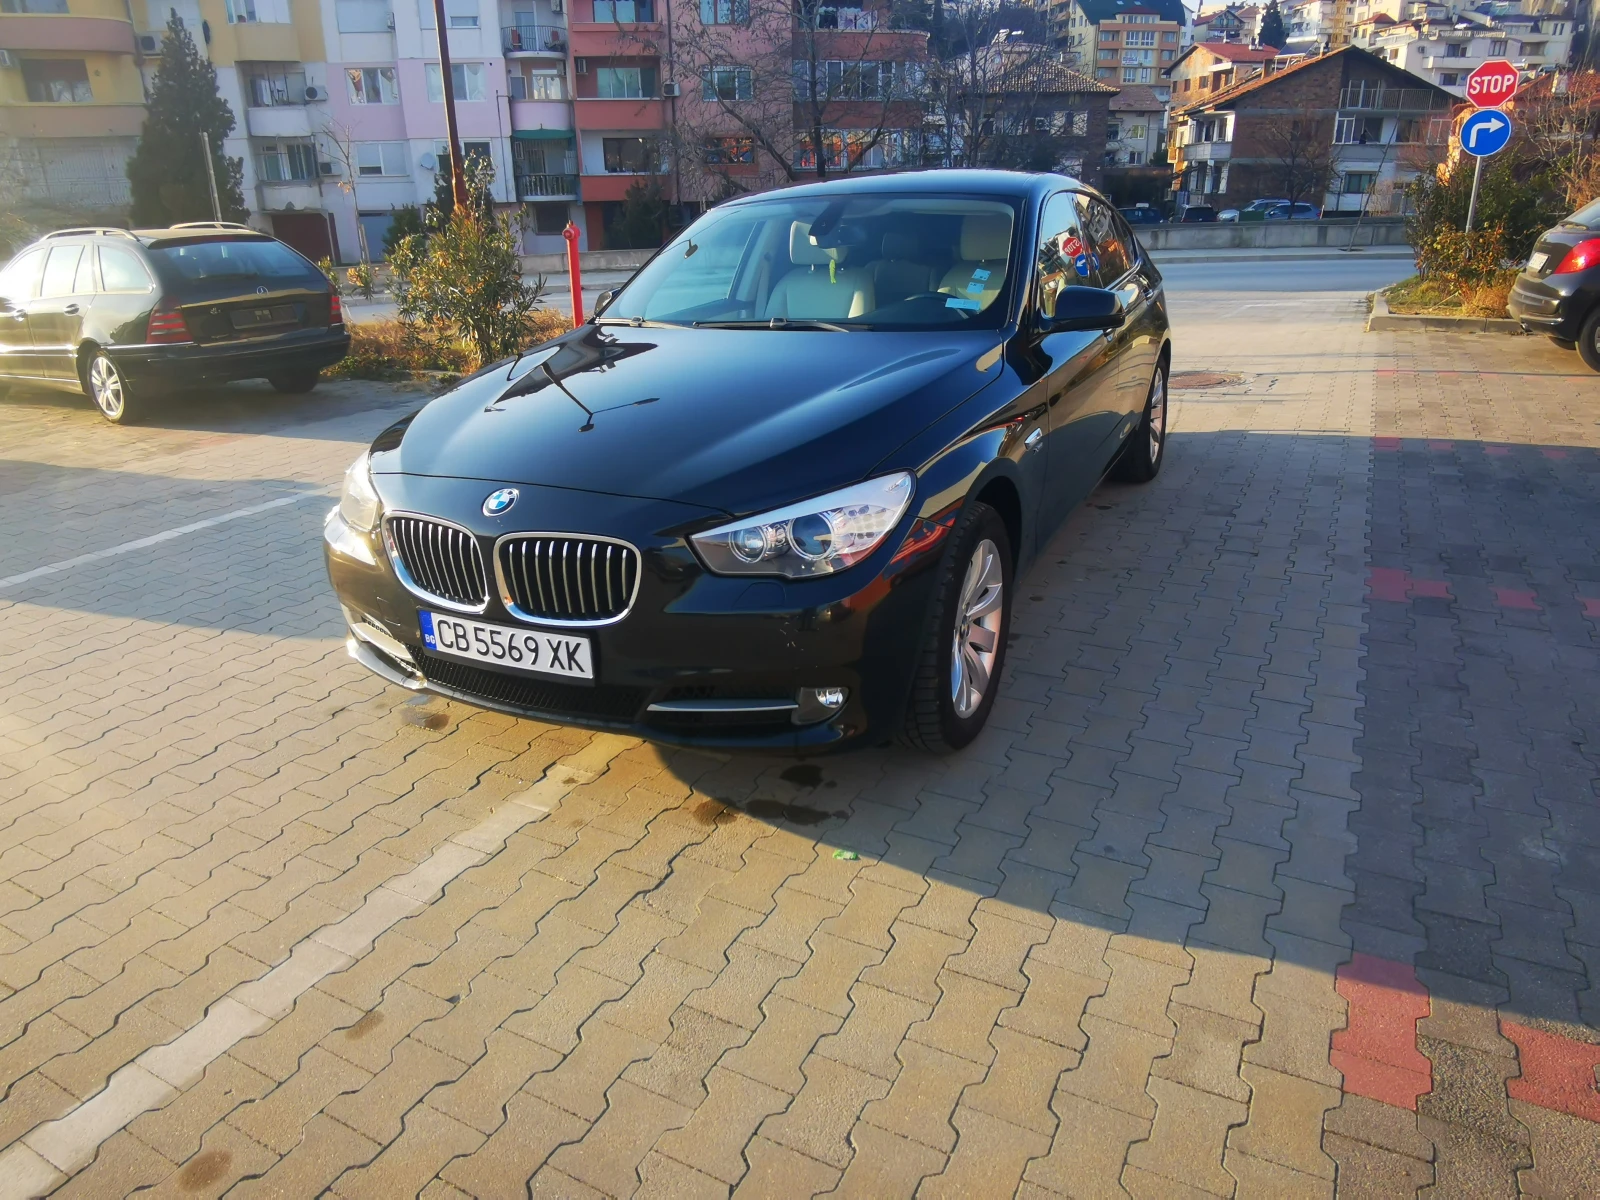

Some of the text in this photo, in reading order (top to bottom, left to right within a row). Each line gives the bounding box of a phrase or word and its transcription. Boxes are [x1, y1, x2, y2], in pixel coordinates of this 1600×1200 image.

[1469, 74, 1515, 95] STOP
[424, 633, 436, 645] BG
[545, 638, 586, 673] XK
